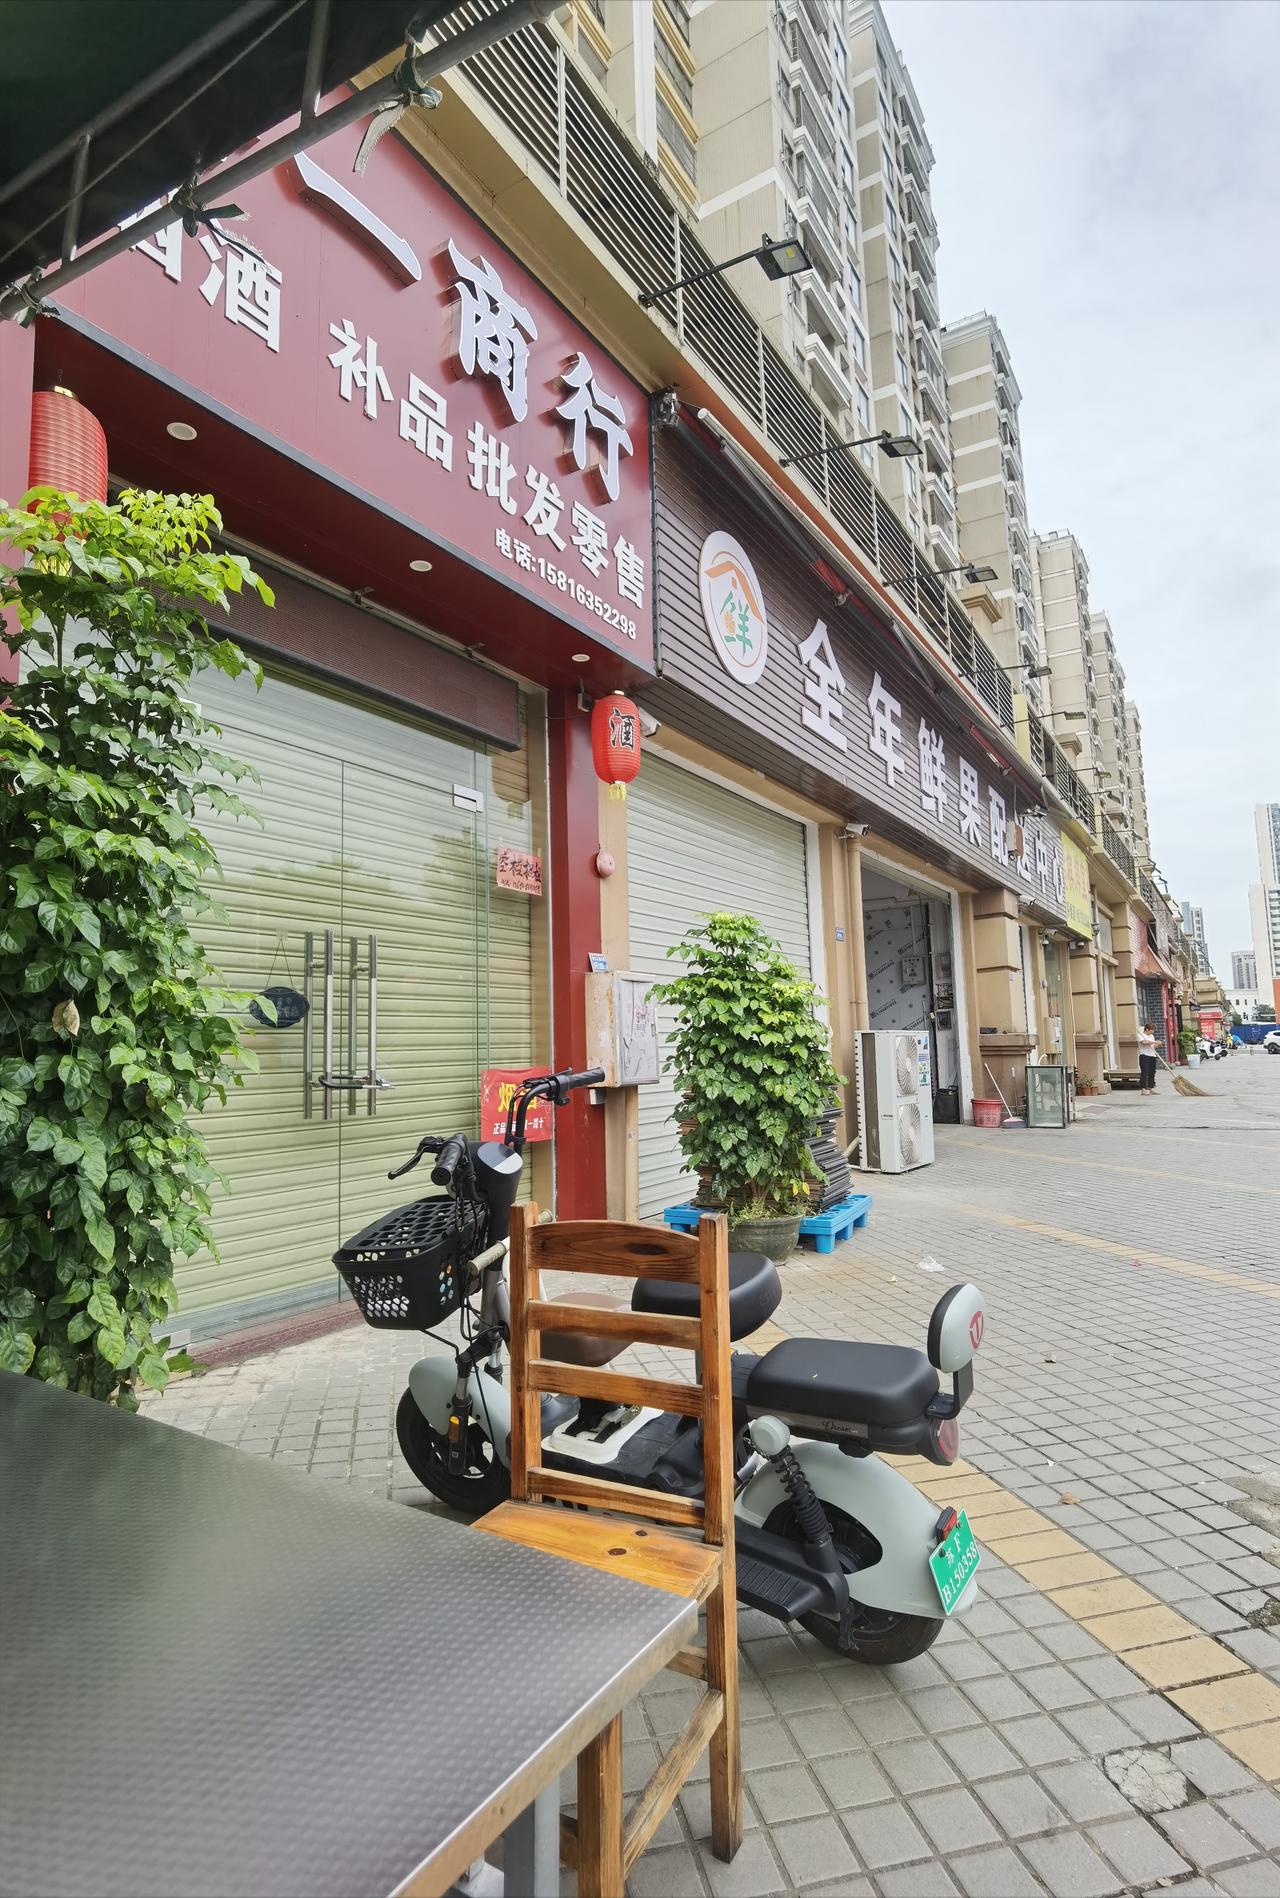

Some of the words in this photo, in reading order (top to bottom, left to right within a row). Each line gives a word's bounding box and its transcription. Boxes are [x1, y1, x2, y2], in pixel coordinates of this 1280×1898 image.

[327, 318, 645, 610] 补品批发零售
[608, 706, 636, 752] 酒
[953, 1532, 962, 1554] F
[943, 1541, 977, 1606] B150358
